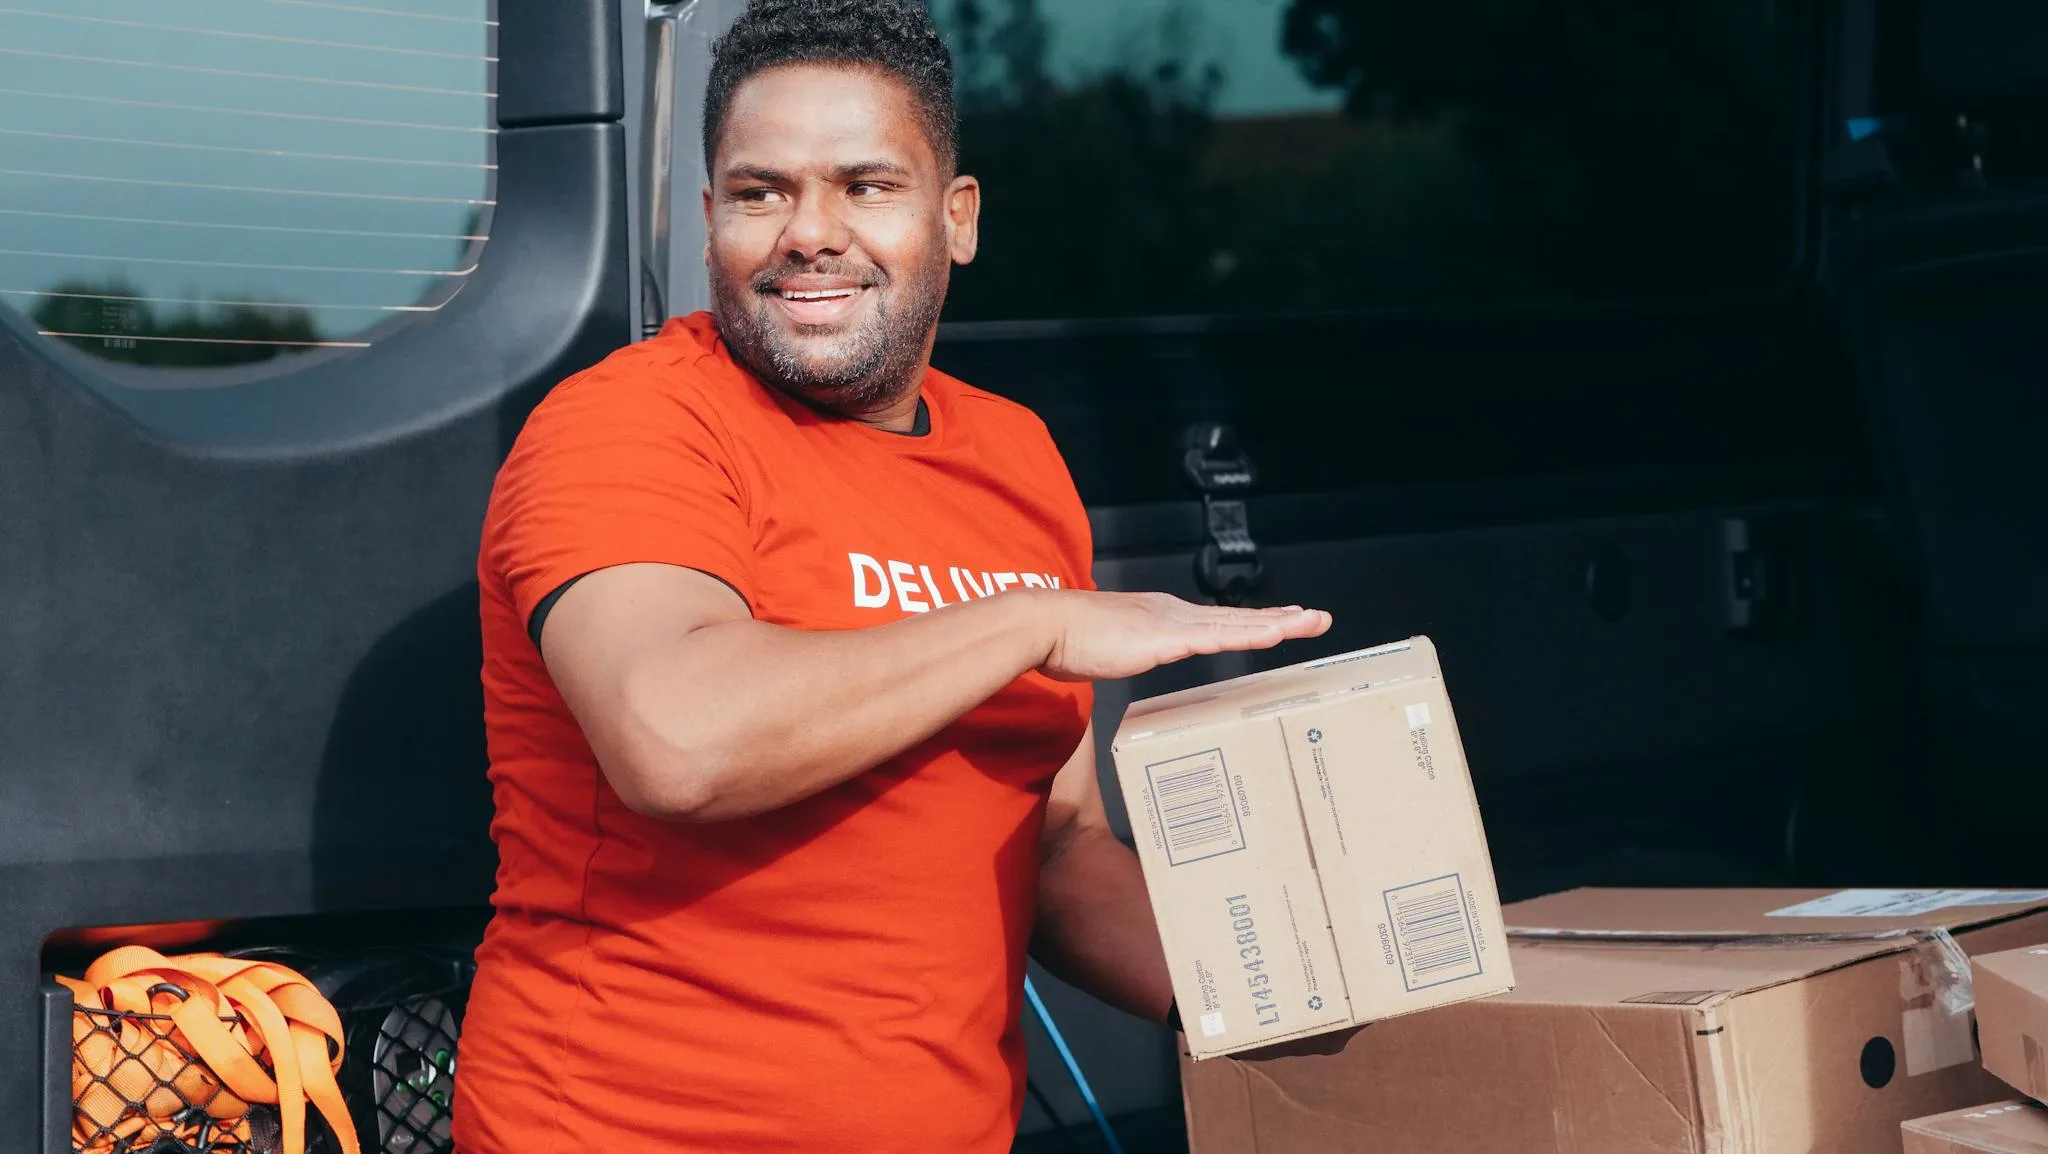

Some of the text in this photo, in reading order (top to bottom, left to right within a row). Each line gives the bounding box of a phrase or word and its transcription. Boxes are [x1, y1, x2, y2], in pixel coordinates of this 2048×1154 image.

[1417, 728, 1430, 754] Mailing
[1424, 754, 1436, 780] Carton
[1146, 807, 1155, 820] THE
[1152, 829, 1162, 849] MADE
[1466, 890, 1476, 910] MADE
[1473, 919, 1481, 932] THE
[1194, 959, 1205, 983] Carton
[1226, 892, 1279, 1027] LT45438001
[1200, 984, 1213, 1011] Mailing
